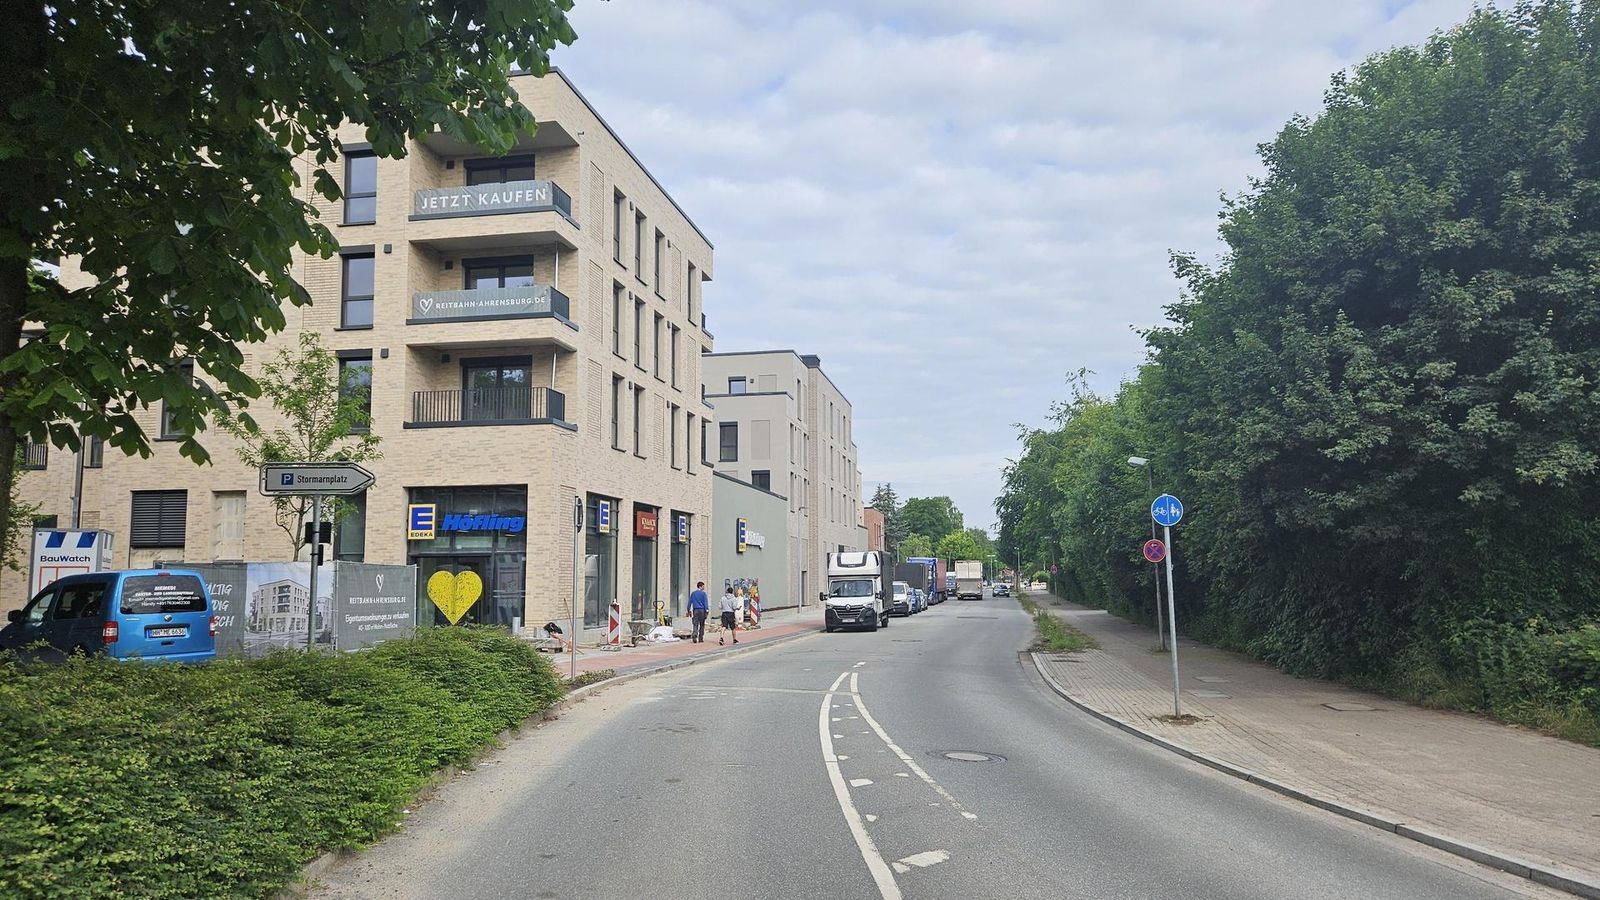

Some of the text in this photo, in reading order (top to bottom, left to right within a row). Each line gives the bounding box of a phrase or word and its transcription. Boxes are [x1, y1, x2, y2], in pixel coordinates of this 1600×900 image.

[421, 188, 546, 209] JETZT KAUFEN
[435, 296, 545, 309] REITBAHN-AHRENSBURG.DE
[297, 475, 348, 485] Stormarnplatz
[412, 507, 433, 530] E
[442, 513, 526, 533] Höfling
